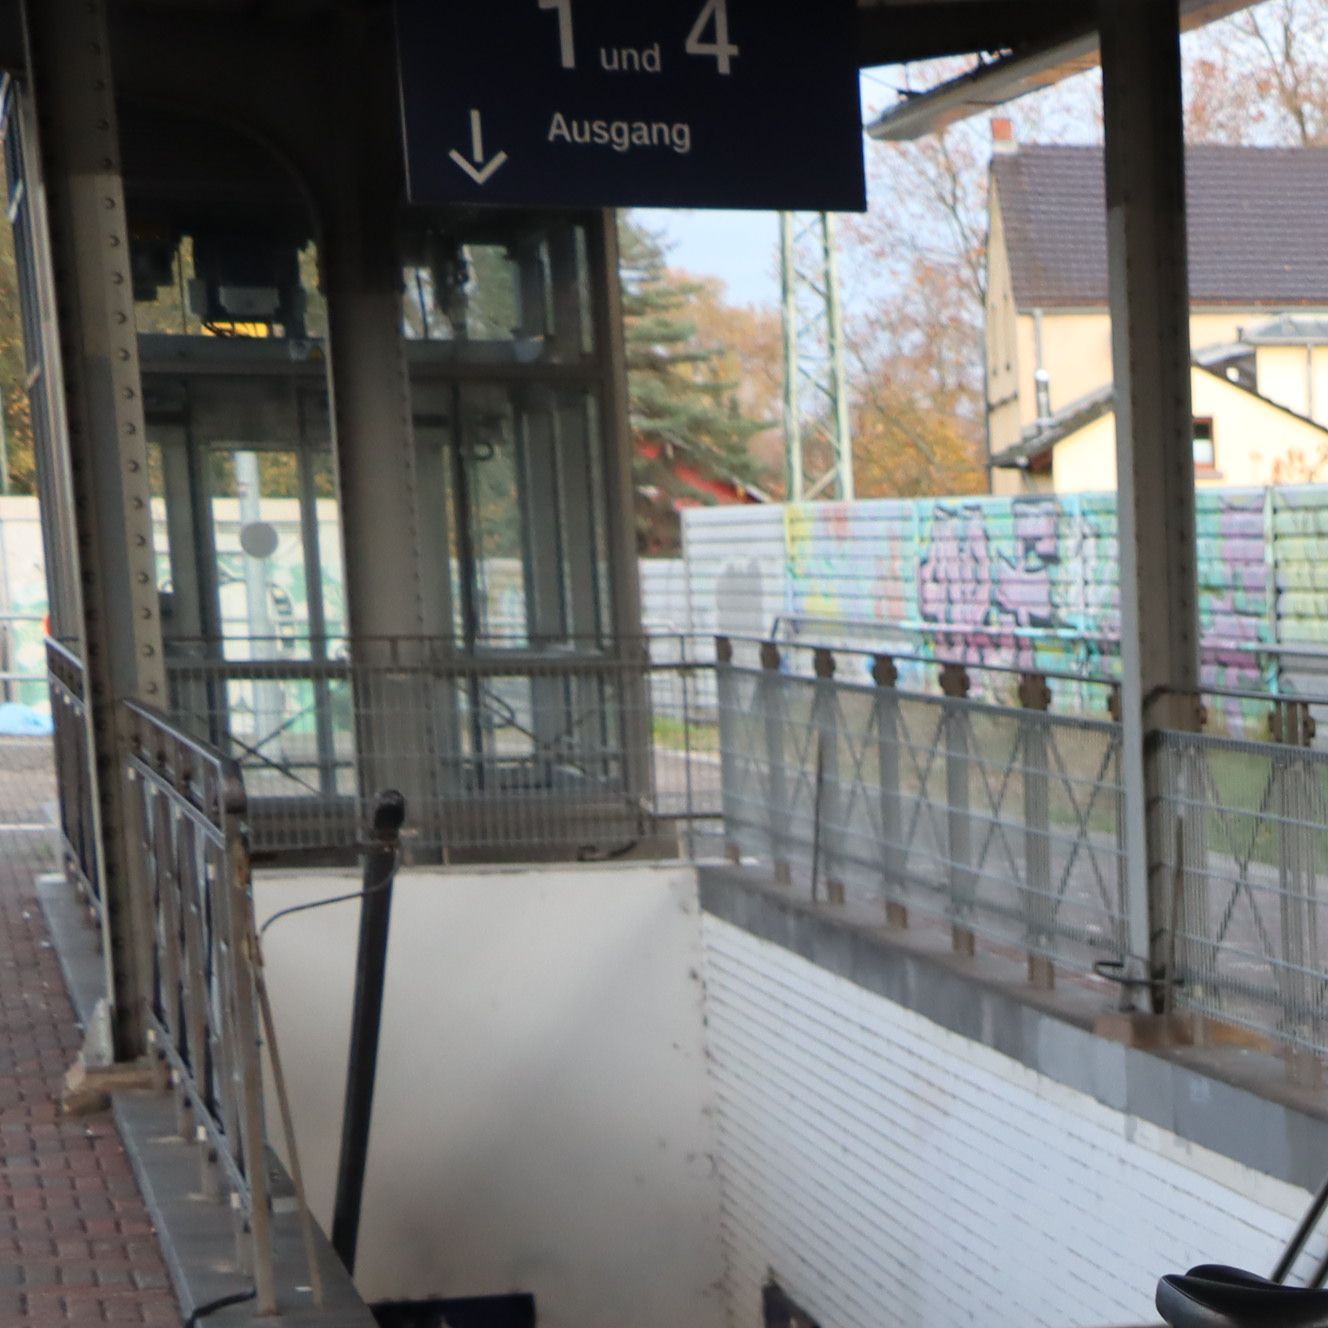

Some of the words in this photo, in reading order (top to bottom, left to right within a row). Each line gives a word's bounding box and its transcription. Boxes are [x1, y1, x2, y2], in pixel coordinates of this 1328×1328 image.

[538, 0, 575, 69] 1
[600, 43, 661, 73] und
[685, 0, 740, 75] 4
[547, 112, 692, 154] Ausgang
